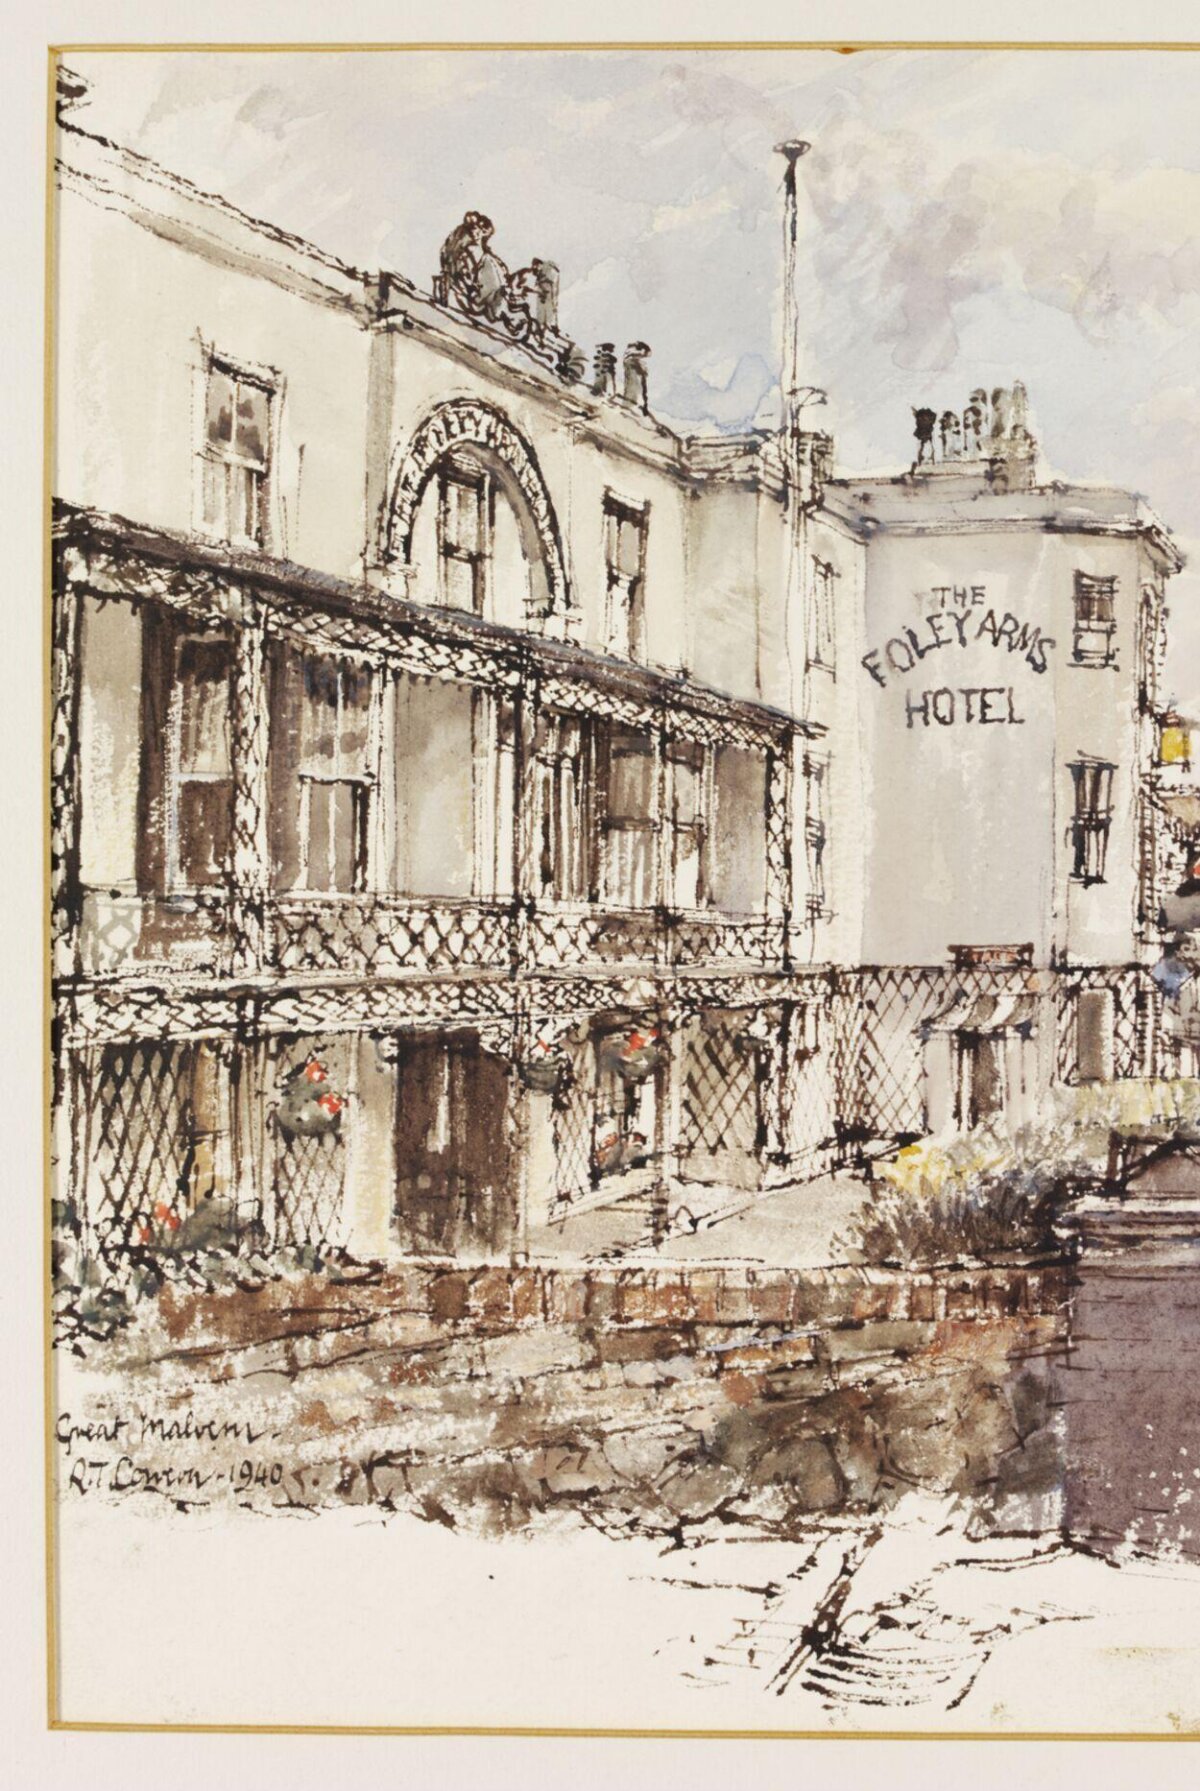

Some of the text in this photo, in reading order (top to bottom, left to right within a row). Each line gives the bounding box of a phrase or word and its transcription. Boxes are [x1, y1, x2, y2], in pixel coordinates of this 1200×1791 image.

[931, 584, 986, 608] THE
[861, 609, 1056, 688] FOLEY ARMS
[906, 686, 1026, 729] HOTEL
[56, 1412, 130, 1456] Great
